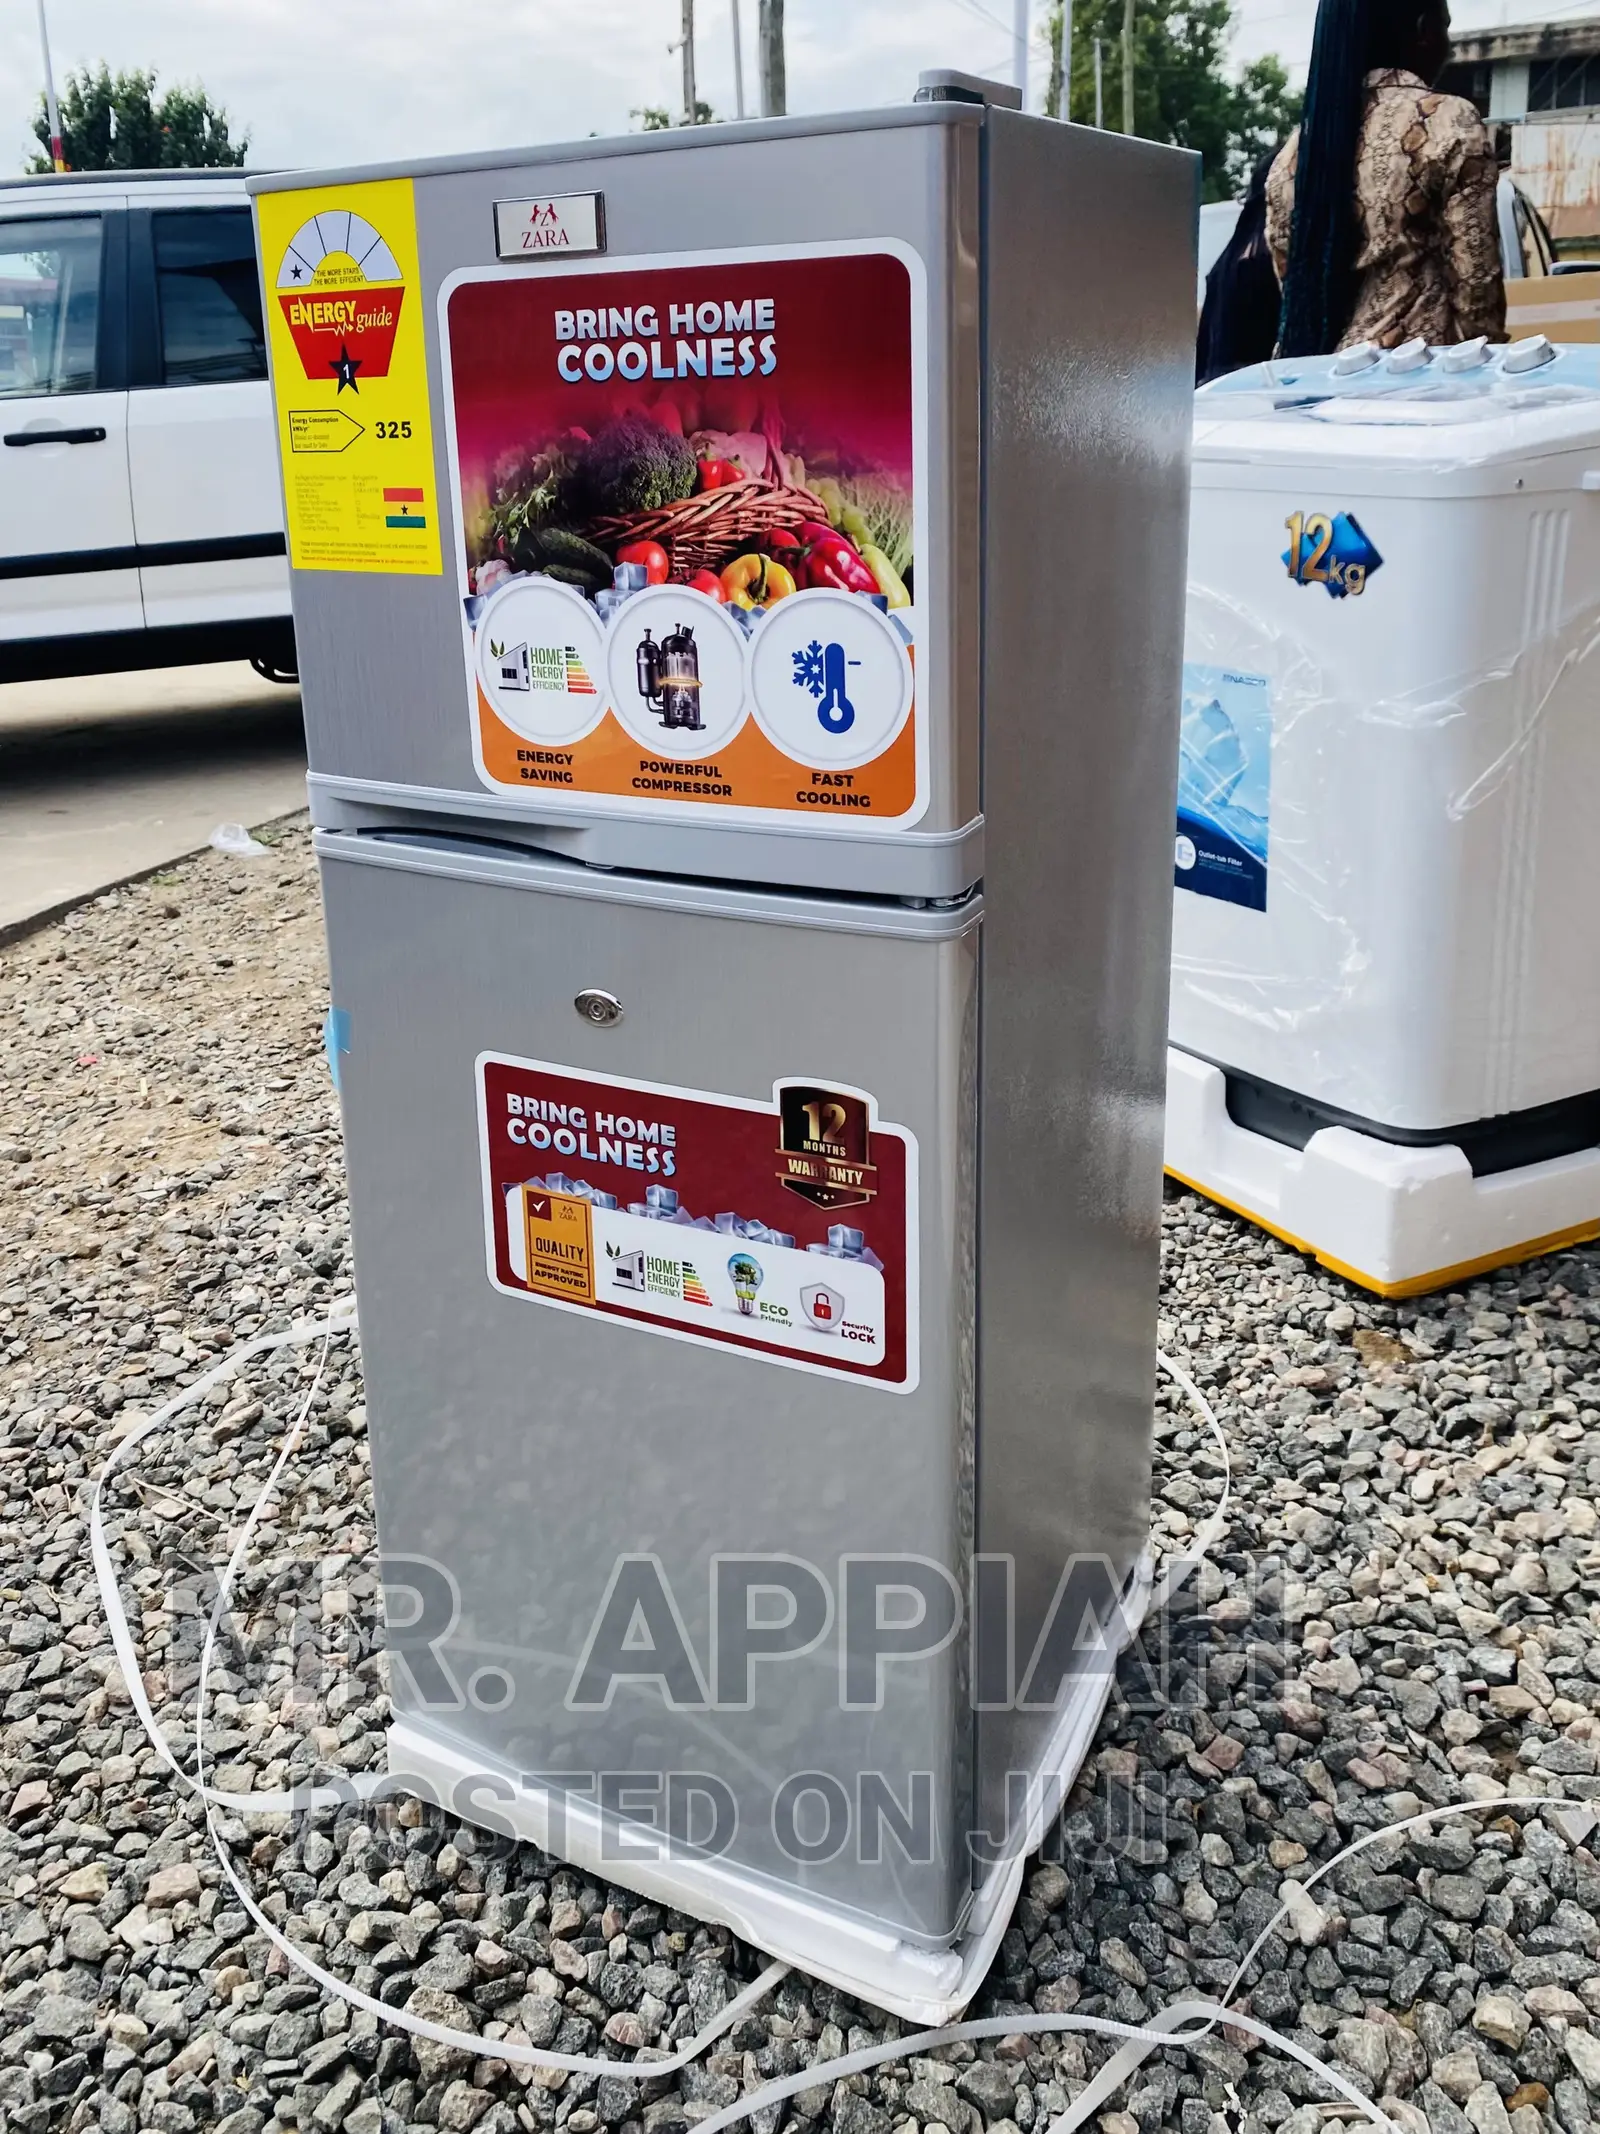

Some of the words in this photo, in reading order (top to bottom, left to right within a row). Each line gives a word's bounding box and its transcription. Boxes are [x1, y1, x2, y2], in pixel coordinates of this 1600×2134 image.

[521, 229, 570, 249] ZARA
[327, 268, 341, 276] MORE
[343, 267, 359, 275] STARS
[340, 276, 363, 284] EFFICIENT
[289, 297, 356, 333] ENERGY
[356, 306, 393, 333] guide
[555, 307, 658, 340] BRING
[669, 298, 775, 334] HOME
[557, 335, 777, 382] COOLNESS
[343, 364, 350, 379] 1
[375, 421, 412, 439] 325
[530, 647, 563, 666] HOME
[532, 665, 564, 680] ENERGY
[533, 680, 565, 691] EFFICIENCY
[517, 749, 573, 766] ENERGY
[520, 768, 573, 784] SAVING
[639, 760, 722, 778] POWERFUL
[631, 777, 732, 797] COMPRESSOR
[811, 772, 854, 788] FAST
[796, 790, 871, 808] COOLING
[506, 1093, 587, 1129] BRING
[595, 1111, 677, 1148] HOME
[801, 1101, 847, 1146] 12
[507, 1118, 677, 1177] COOLNESS
[803, 1140, 847, 1157] MONTHS
[788, 1158, 863, 1185] WARRANTY
[535, 1237, 584, 1262] QUALITY
[535, 1262, 559, 1272] ENERGY
[560, 1267, 584, 1278] RATING
[646, 1256, 680, 1276] HOME
[534, 1269, 587, 1288] APPROVED
[647, 1272, 680, 1288] ENERGY
[647, 1284, 681, 1298] EFFICIENCY
[760, 1302, 789, 1317] ECO
[760, 1314, 793, 1327] Friendly
[841, 1320, 874, 1333] Security
[841, 1329, 876, 1344] LOCK
